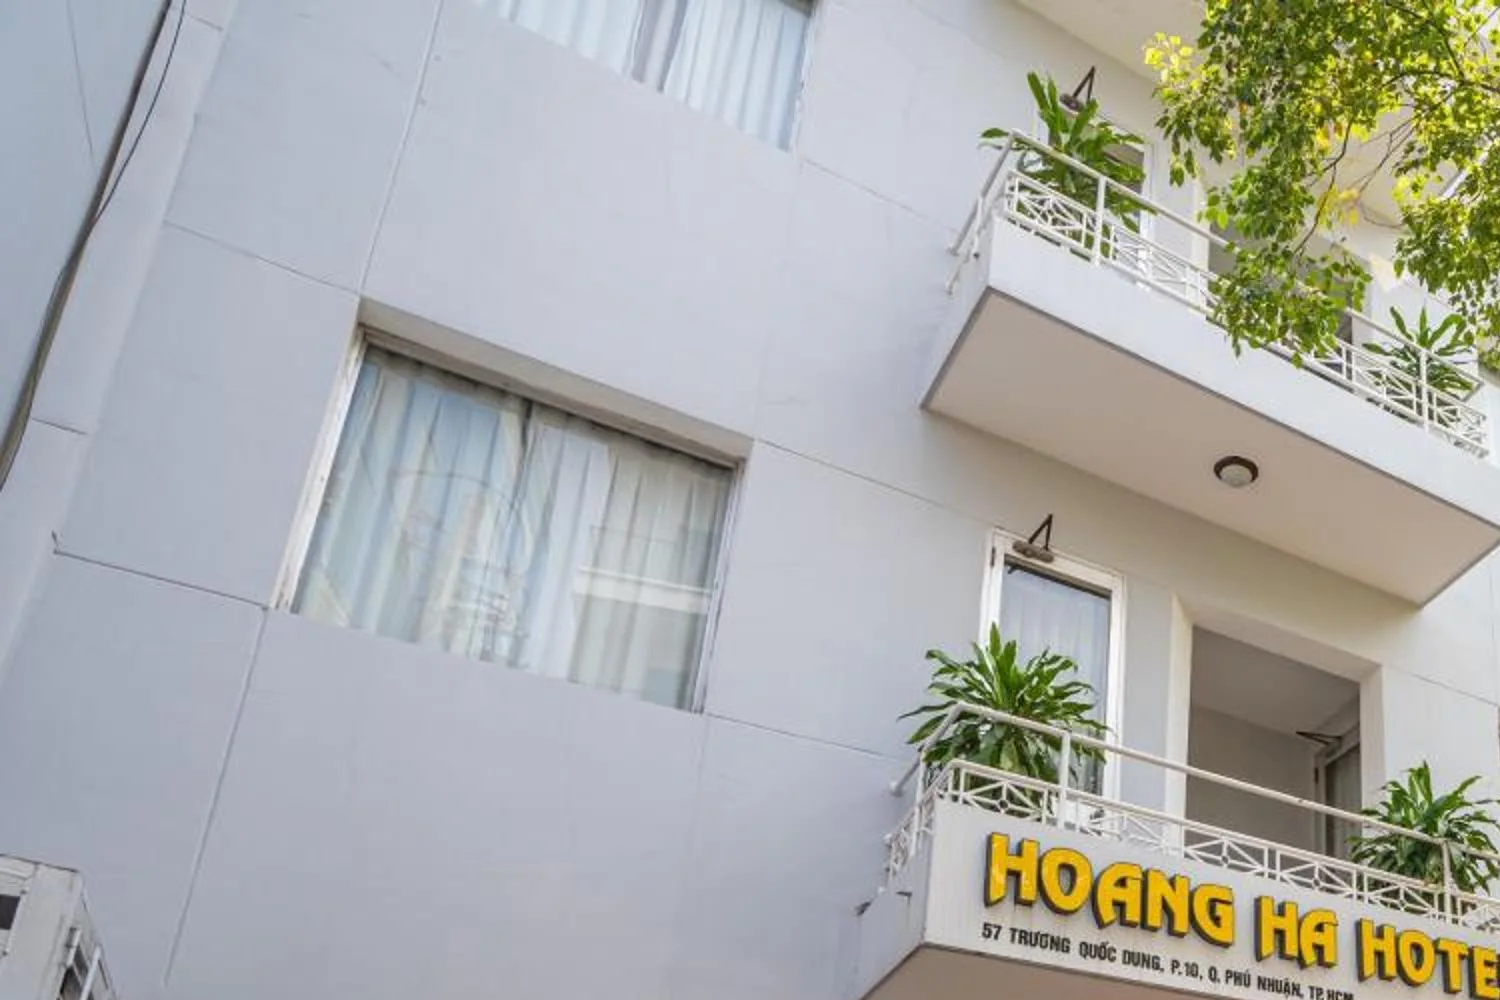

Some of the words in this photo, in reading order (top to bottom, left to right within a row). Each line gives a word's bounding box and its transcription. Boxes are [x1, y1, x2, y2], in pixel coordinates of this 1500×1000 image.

[985, 832, 1235, 947] HOANG
[1256, 895, 1339, 969] HA
[981, 922, 1002, 941] 57
[1079, 939, 1117, 963] QUỐC
[1225, 967, 1251, 989] PHÚ
